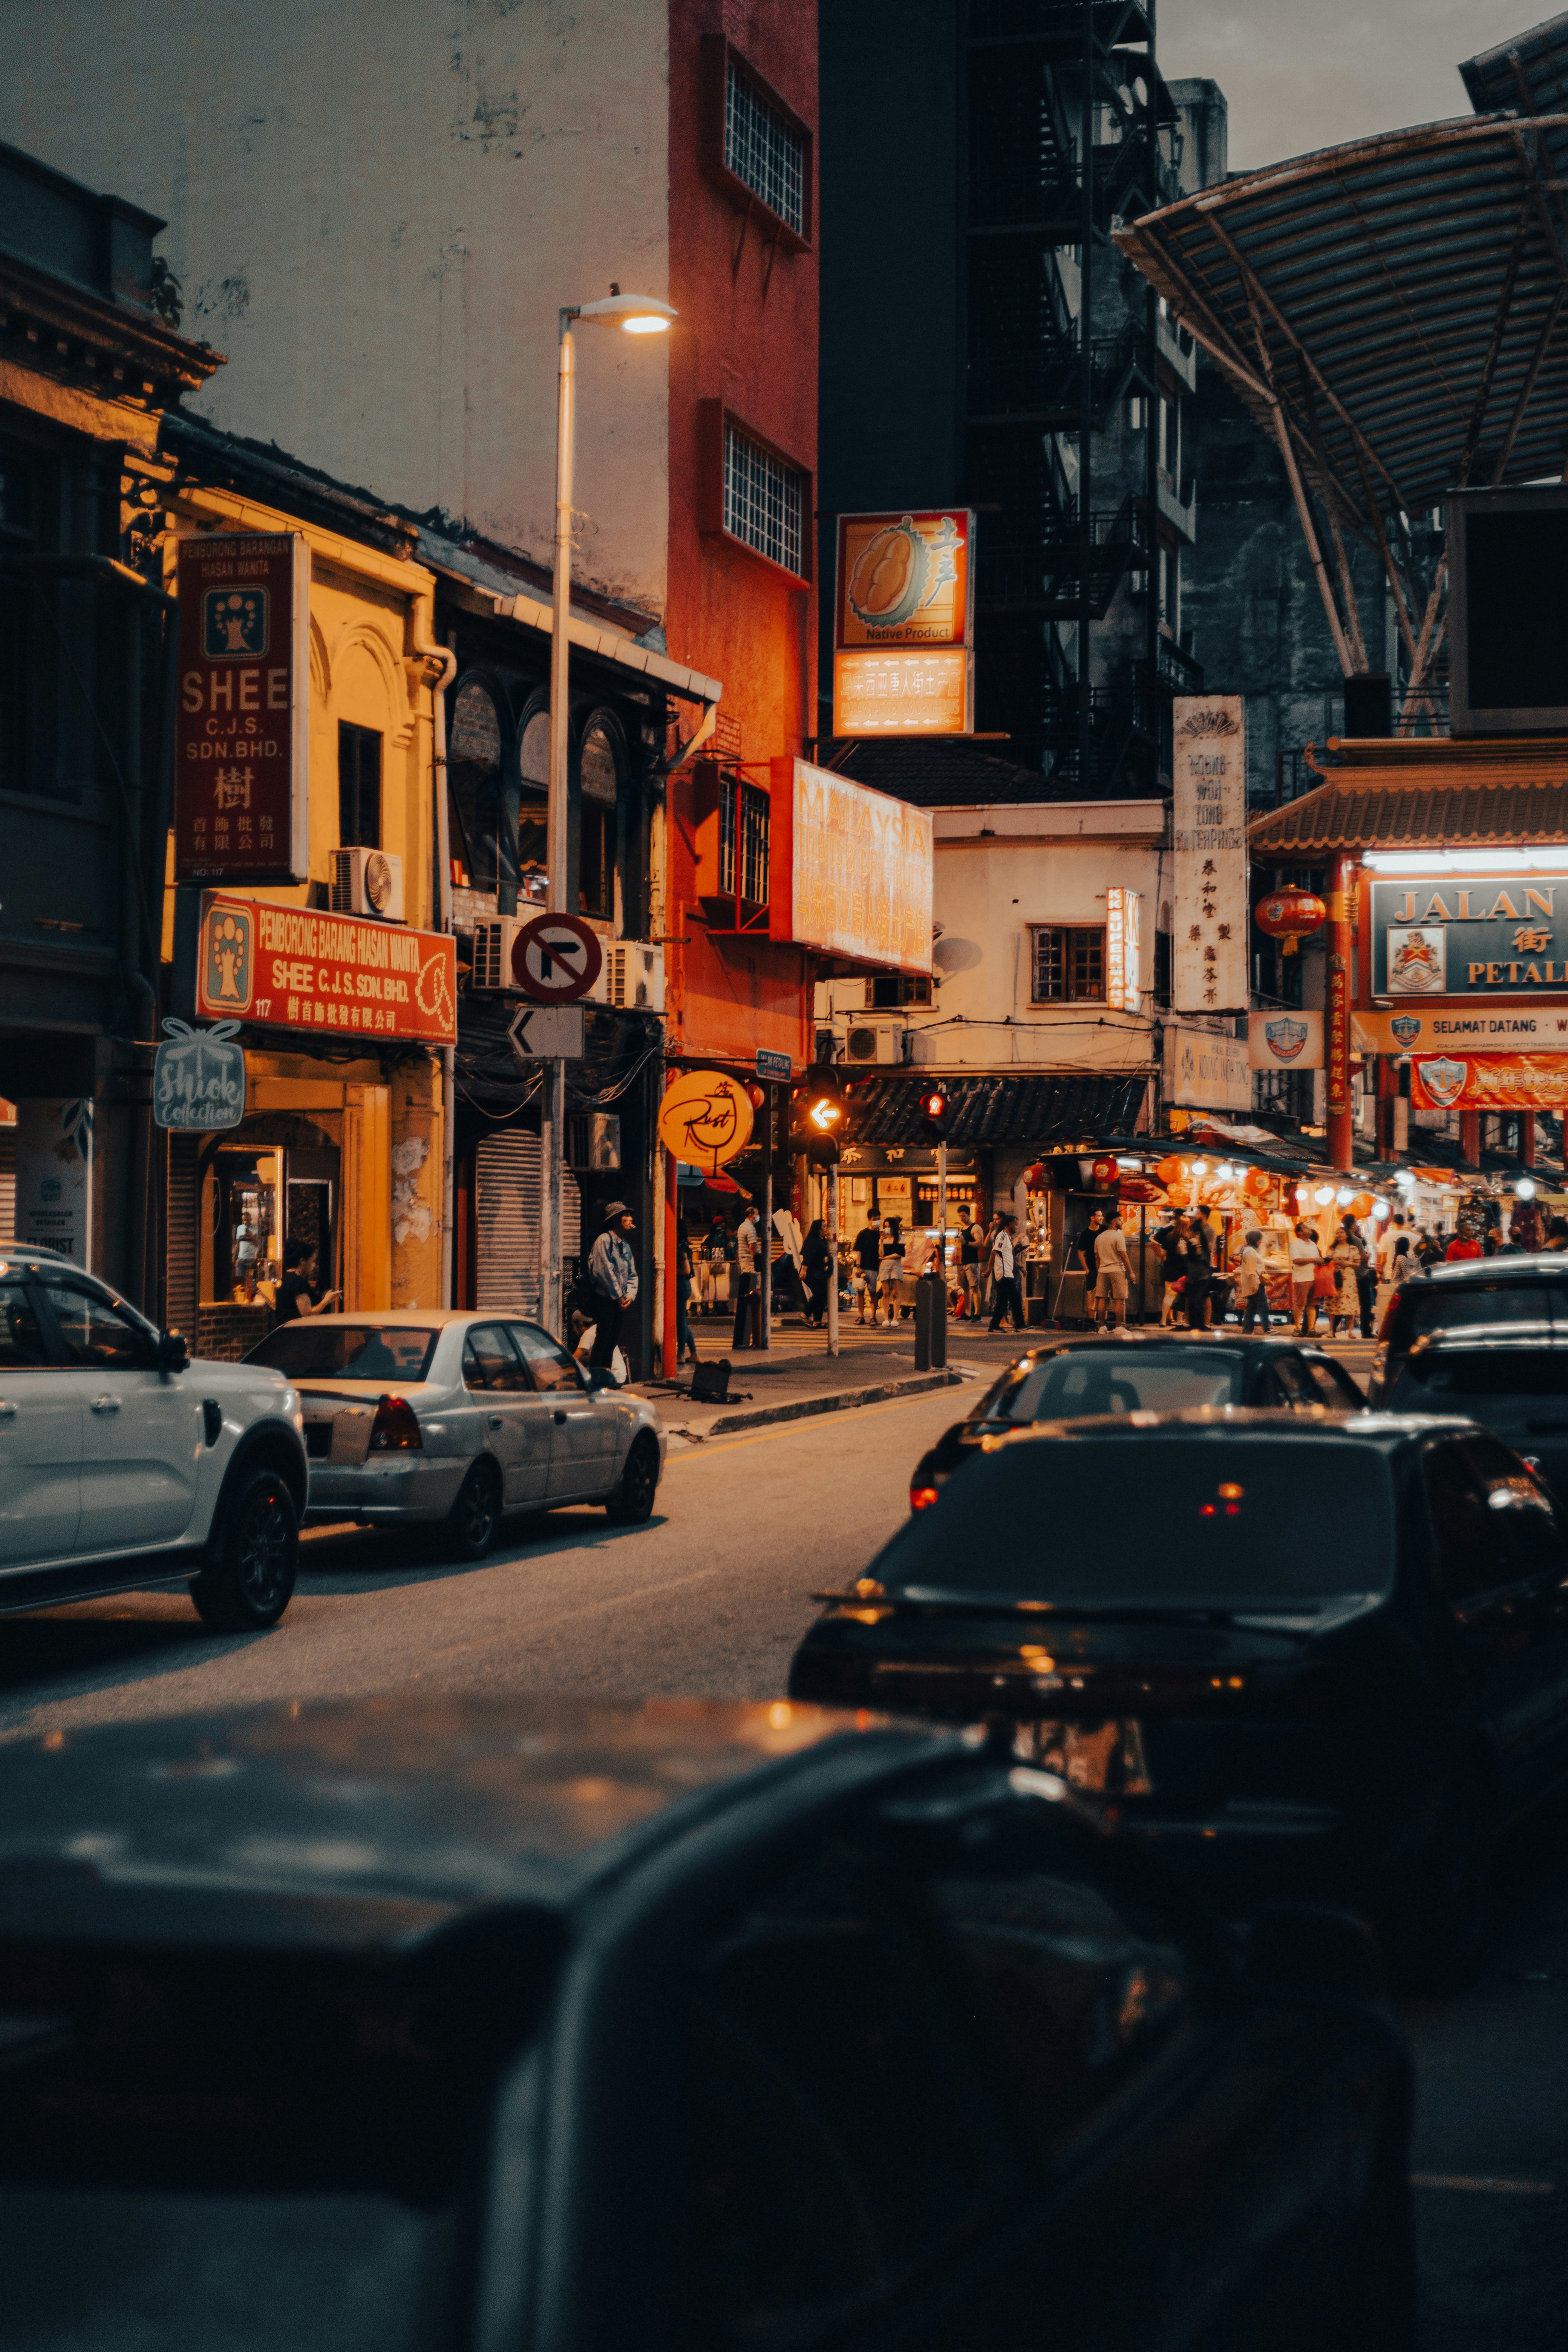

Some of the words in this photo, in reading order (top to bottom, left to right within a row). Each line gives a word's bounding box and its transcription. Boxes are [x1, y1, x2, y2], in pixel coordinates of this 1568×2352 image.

[182, 541, 236, 558] PEMBORONG
[240, 539, 289, 557] BARANGAN
[201, 561, 233, 577] HIASAN
[237, 560, 270, 576] WANITA
[867, 628, 902, 640] Native
[905, 627, 949, 639] Product
[182, 668, 288, 712] SHEE
[205, 717, 264, 735] C.J.S.
[213, 766, 255, 809] 樹
[798, 779, 927, 859] MALAYSIA
[193, 833, 274, 851] 有限公司
[1176, 828, 1243, 851] ENTERPRISE
[211, 868, 224, 876] 117
[796, 822, 843, 870] TITBITS
[846, 841, 857, 874] &
[860, 845, 885, 883] DRY
[889, 856, 926, 896] FRUITS
[1109, 889, 1121, 909] KK
[1395, 888, 1557, 922] JALAN
[259, 910, 317, 957] PEMBORONG
[318, 919, 355, 964] BARANG
[358, 926, 389, 968] HIASAN
[390, 933, 420, 973] WANITA
[1109, 911, 1122, 963] SUPER
[1513, 926, 1553, 953] 街
[272, 959, 314, 993] SHEE
[357, 974, 381, 1000] SDN.
[384, 980, 409, 1003] BHD.
[256, 999, 271, 1017] 117
[287, 996, 396, 1032] 樹首飾批發有限公司
[1433, 1020, 1486, 1034] SELAMAT
[1490, 1019, 1537, 1033] DATANG
[773, 1056, 790, 1070] PETALING
[1476, 1066, 1568, 1093] 新年快乐
[162, 1100, 237, 1125] Collection
[663, 1099, 734, 1130] Rust
